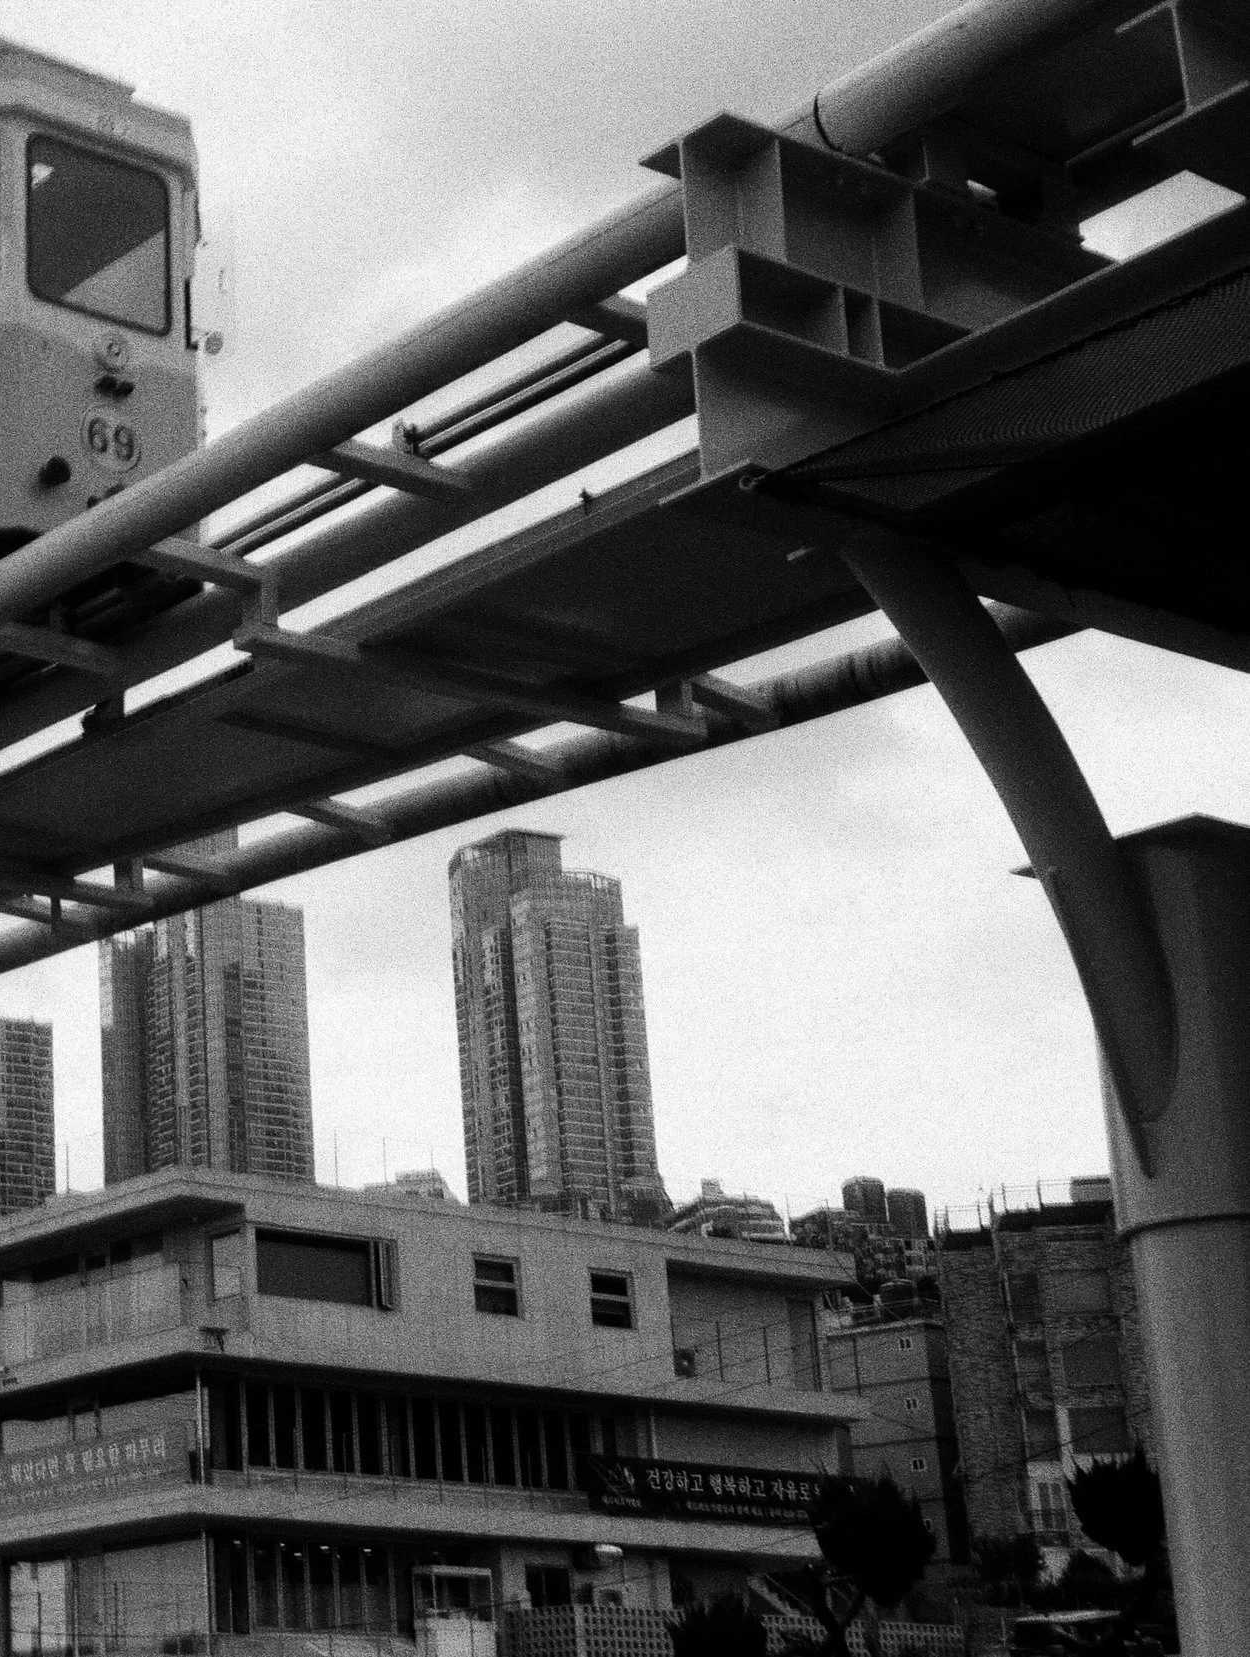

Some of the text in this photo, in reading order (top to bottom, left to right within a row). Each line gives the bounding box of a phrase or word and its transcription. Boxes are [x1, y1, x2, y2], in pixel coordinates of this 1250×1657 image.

[87, 416, 136, 462] 69
[125, 1433, 168, 1463] 마무리
[645, 1468, 704, 1492] 건강하고
[708, 1473, 766, 1497] 행복하고
